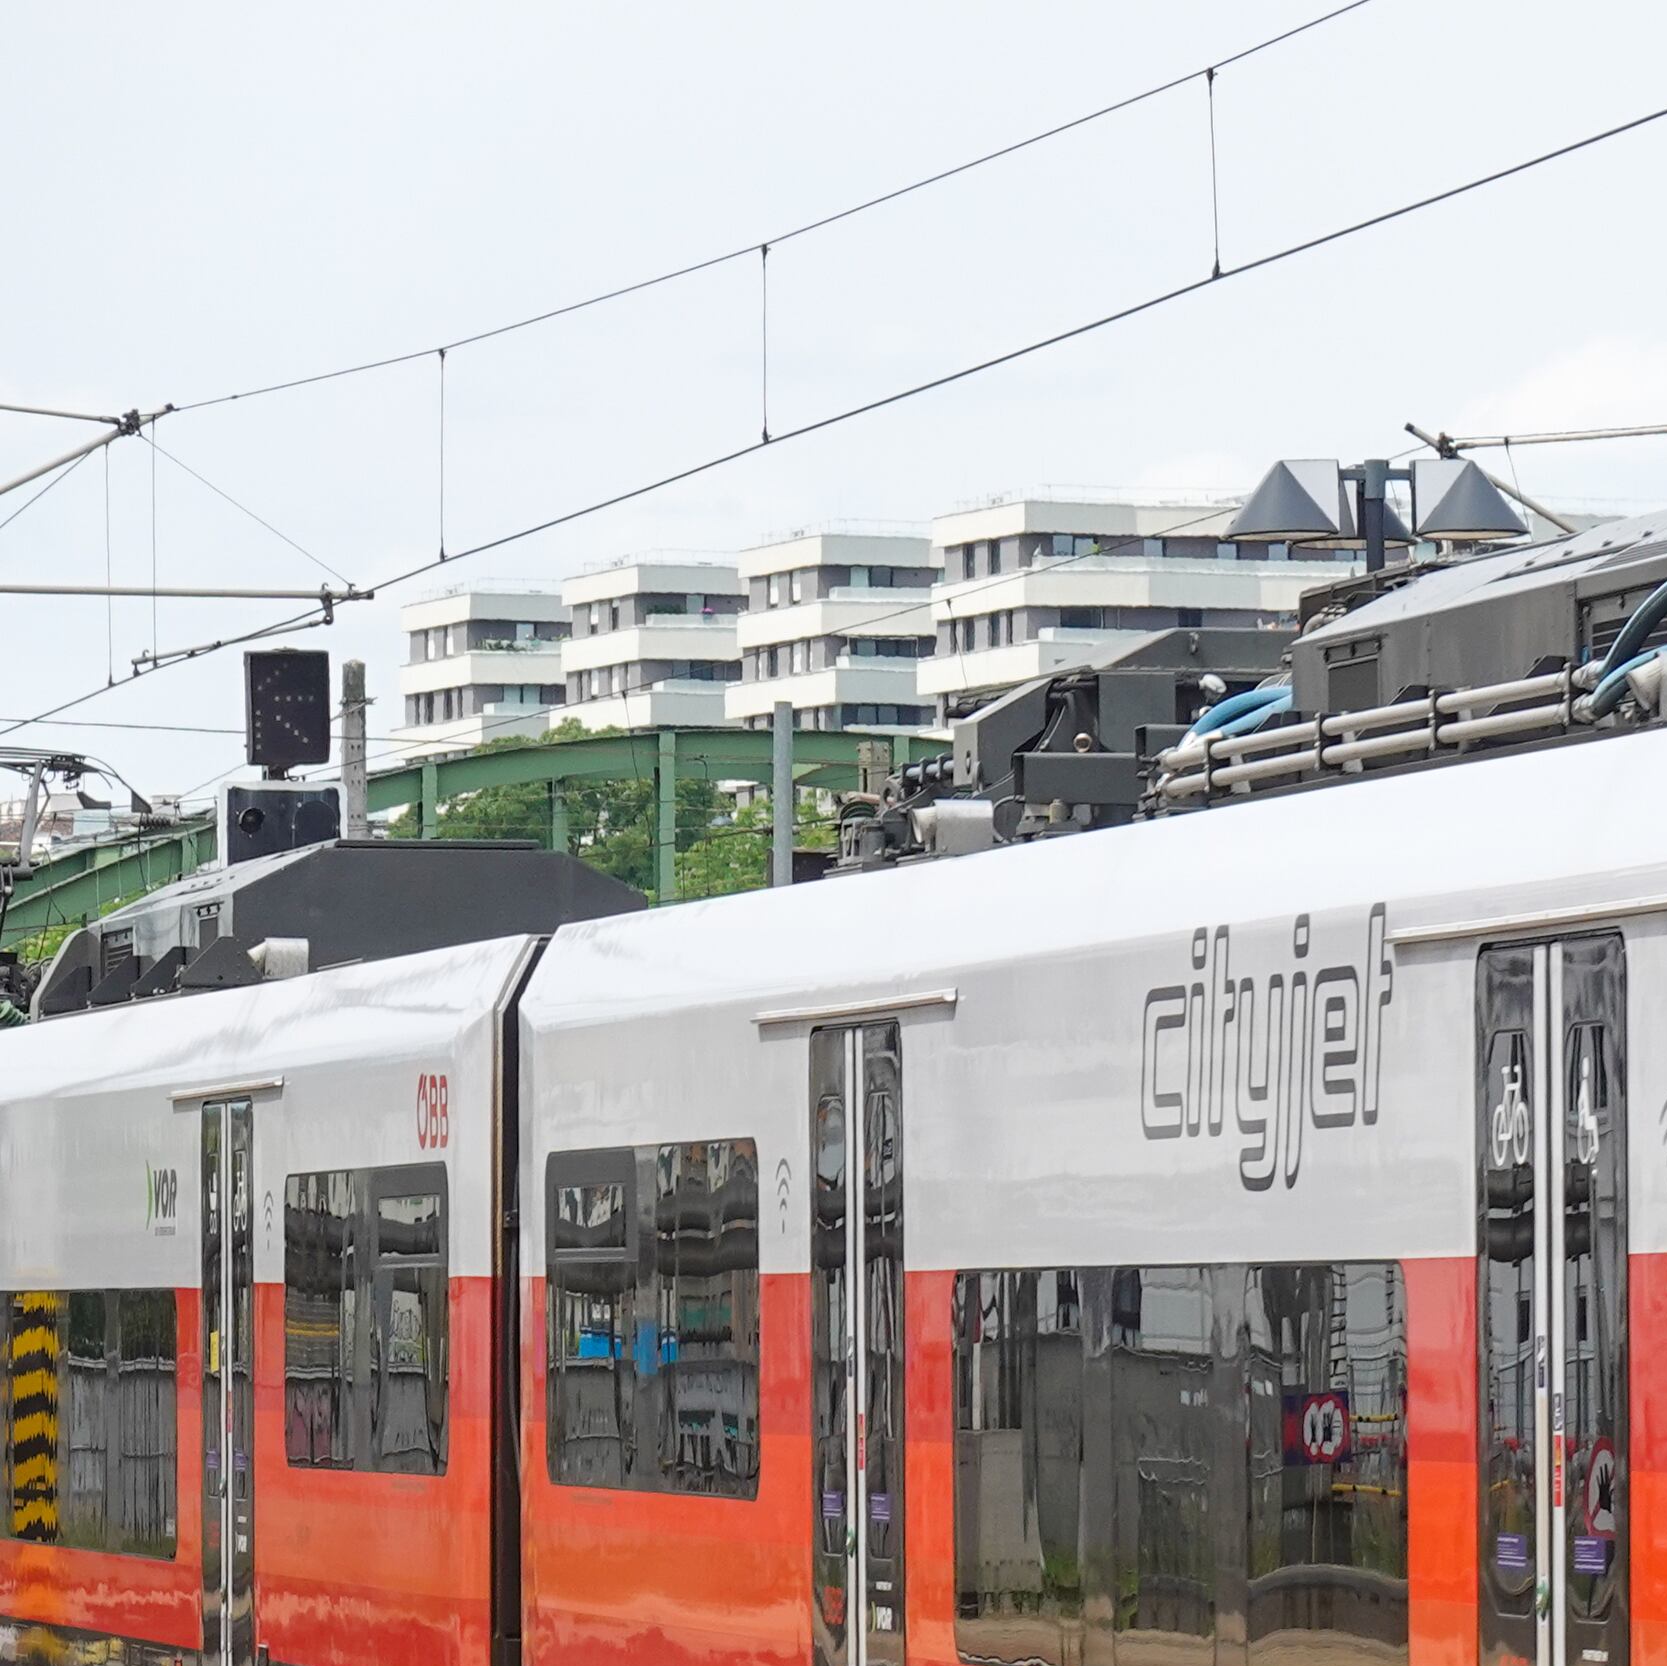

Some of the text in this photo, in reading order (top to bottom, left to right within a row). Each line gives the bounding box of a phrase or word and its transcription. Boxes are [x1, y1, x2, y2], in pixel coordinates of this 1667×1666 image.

[1140, 902, 1392, 1191] cityjet
[417, 1073, 448, 1150] ÖBB
[153, 1168, 177, 1219] VOR
